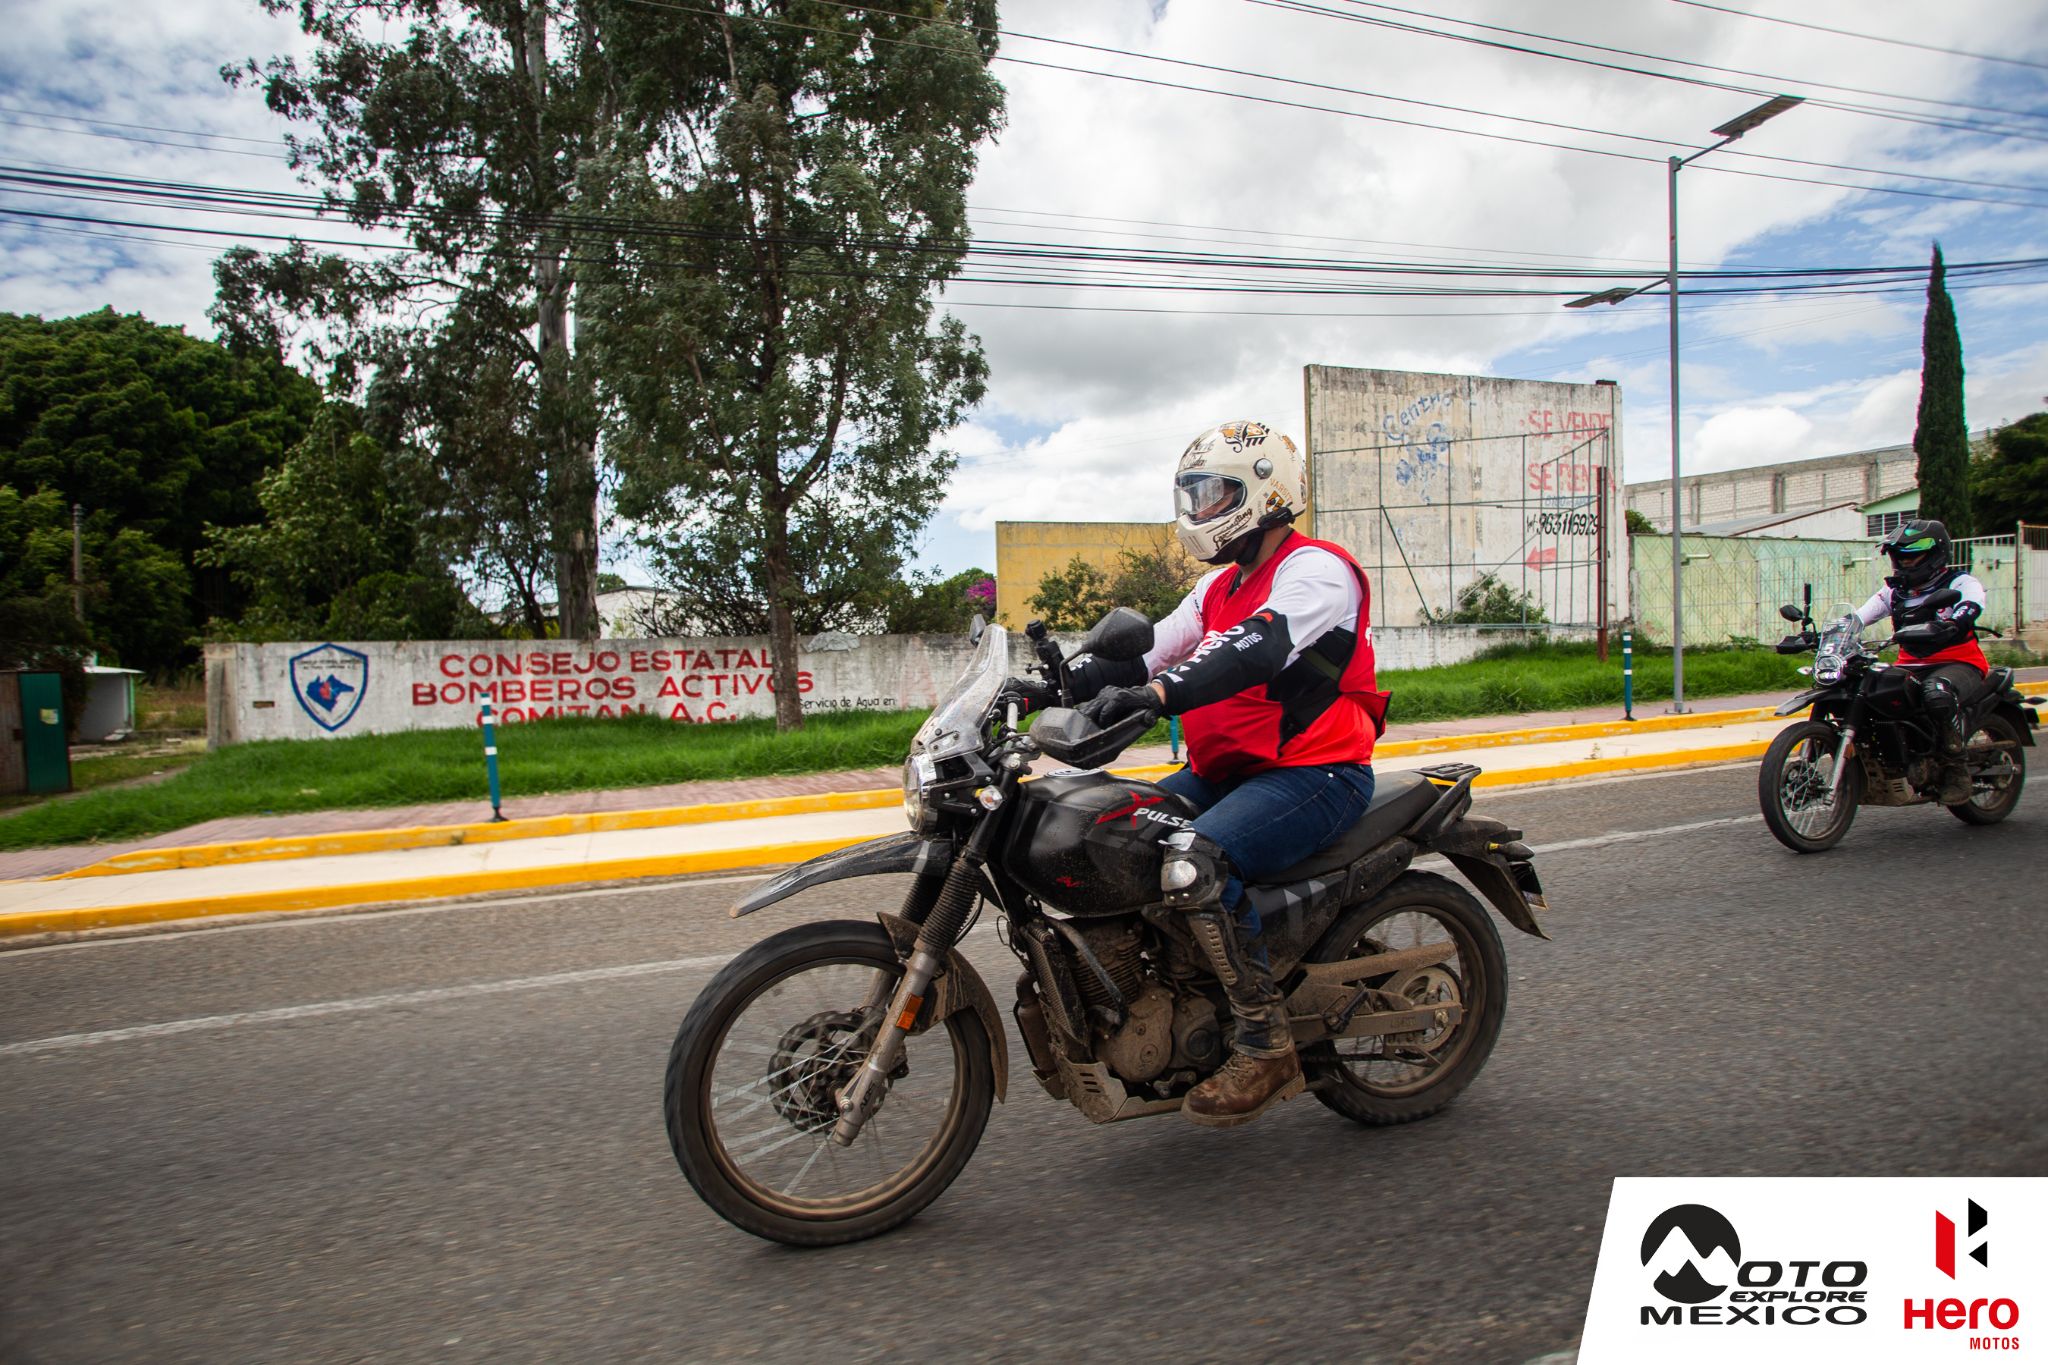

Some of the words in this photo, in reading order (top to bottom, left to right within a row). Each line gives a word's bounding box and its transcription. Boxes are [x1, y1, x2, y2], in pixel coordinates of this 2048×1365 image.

[1527, 410, 1552, 438] SE
[1527, 463, 1552, 491] SE
[1233, 632, 1263, 652] MOTOS
[439, 651, 621, 678] CONSEJO
[630, 648, 774, 672] ESTATAL
[412, 676, 636, 706] BOMBEROS
[840, 696, 852, 708] de
[857, 697, 879, 709] Agua
[883, 698, 896, 706] en
[671, 701, 737, 723] A.C.
